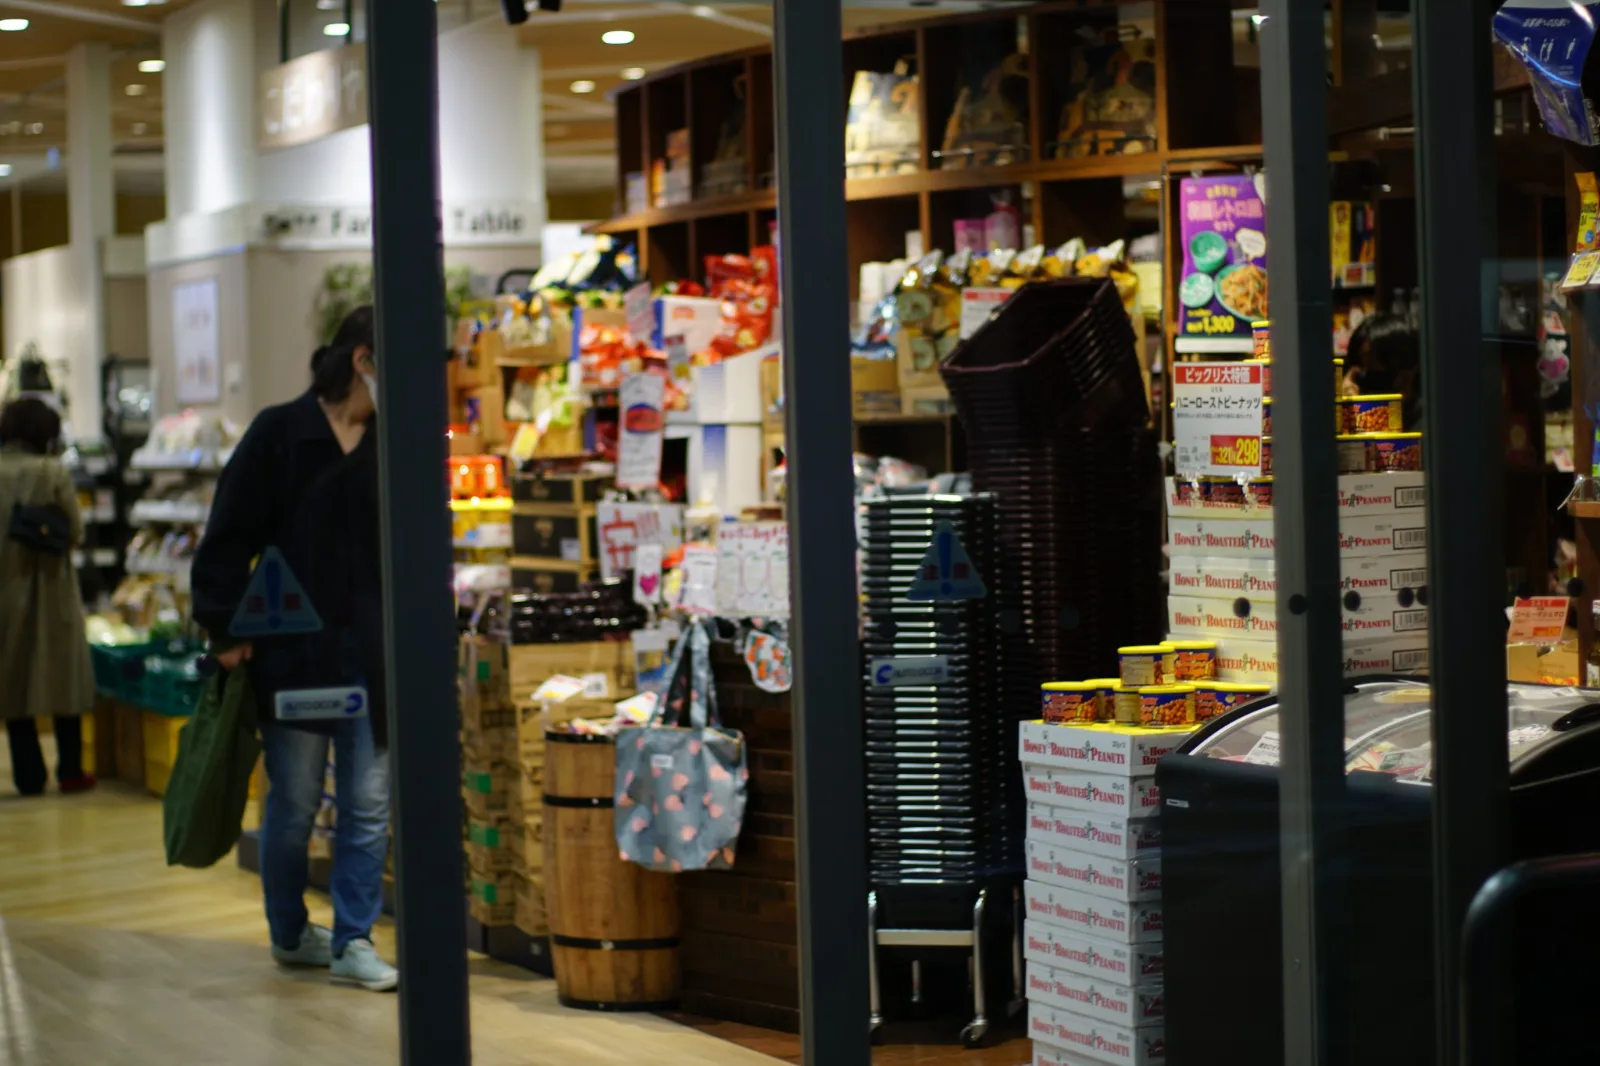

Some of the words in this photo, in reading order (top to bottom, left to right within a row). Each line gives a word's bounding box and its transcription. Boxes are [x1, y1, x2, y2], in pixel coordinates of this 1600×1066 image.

[1236, 438, 1259, 465] 298
[1024, 739, 1046, 754] HONEY
[1050, 742, 1084, 759] ROASTED
[1091, 747, 1125, 764] PEANUTS
[1029, 777, 1050, 794] HONEY
[1093, 788, 1124, 805] PEANUTS
